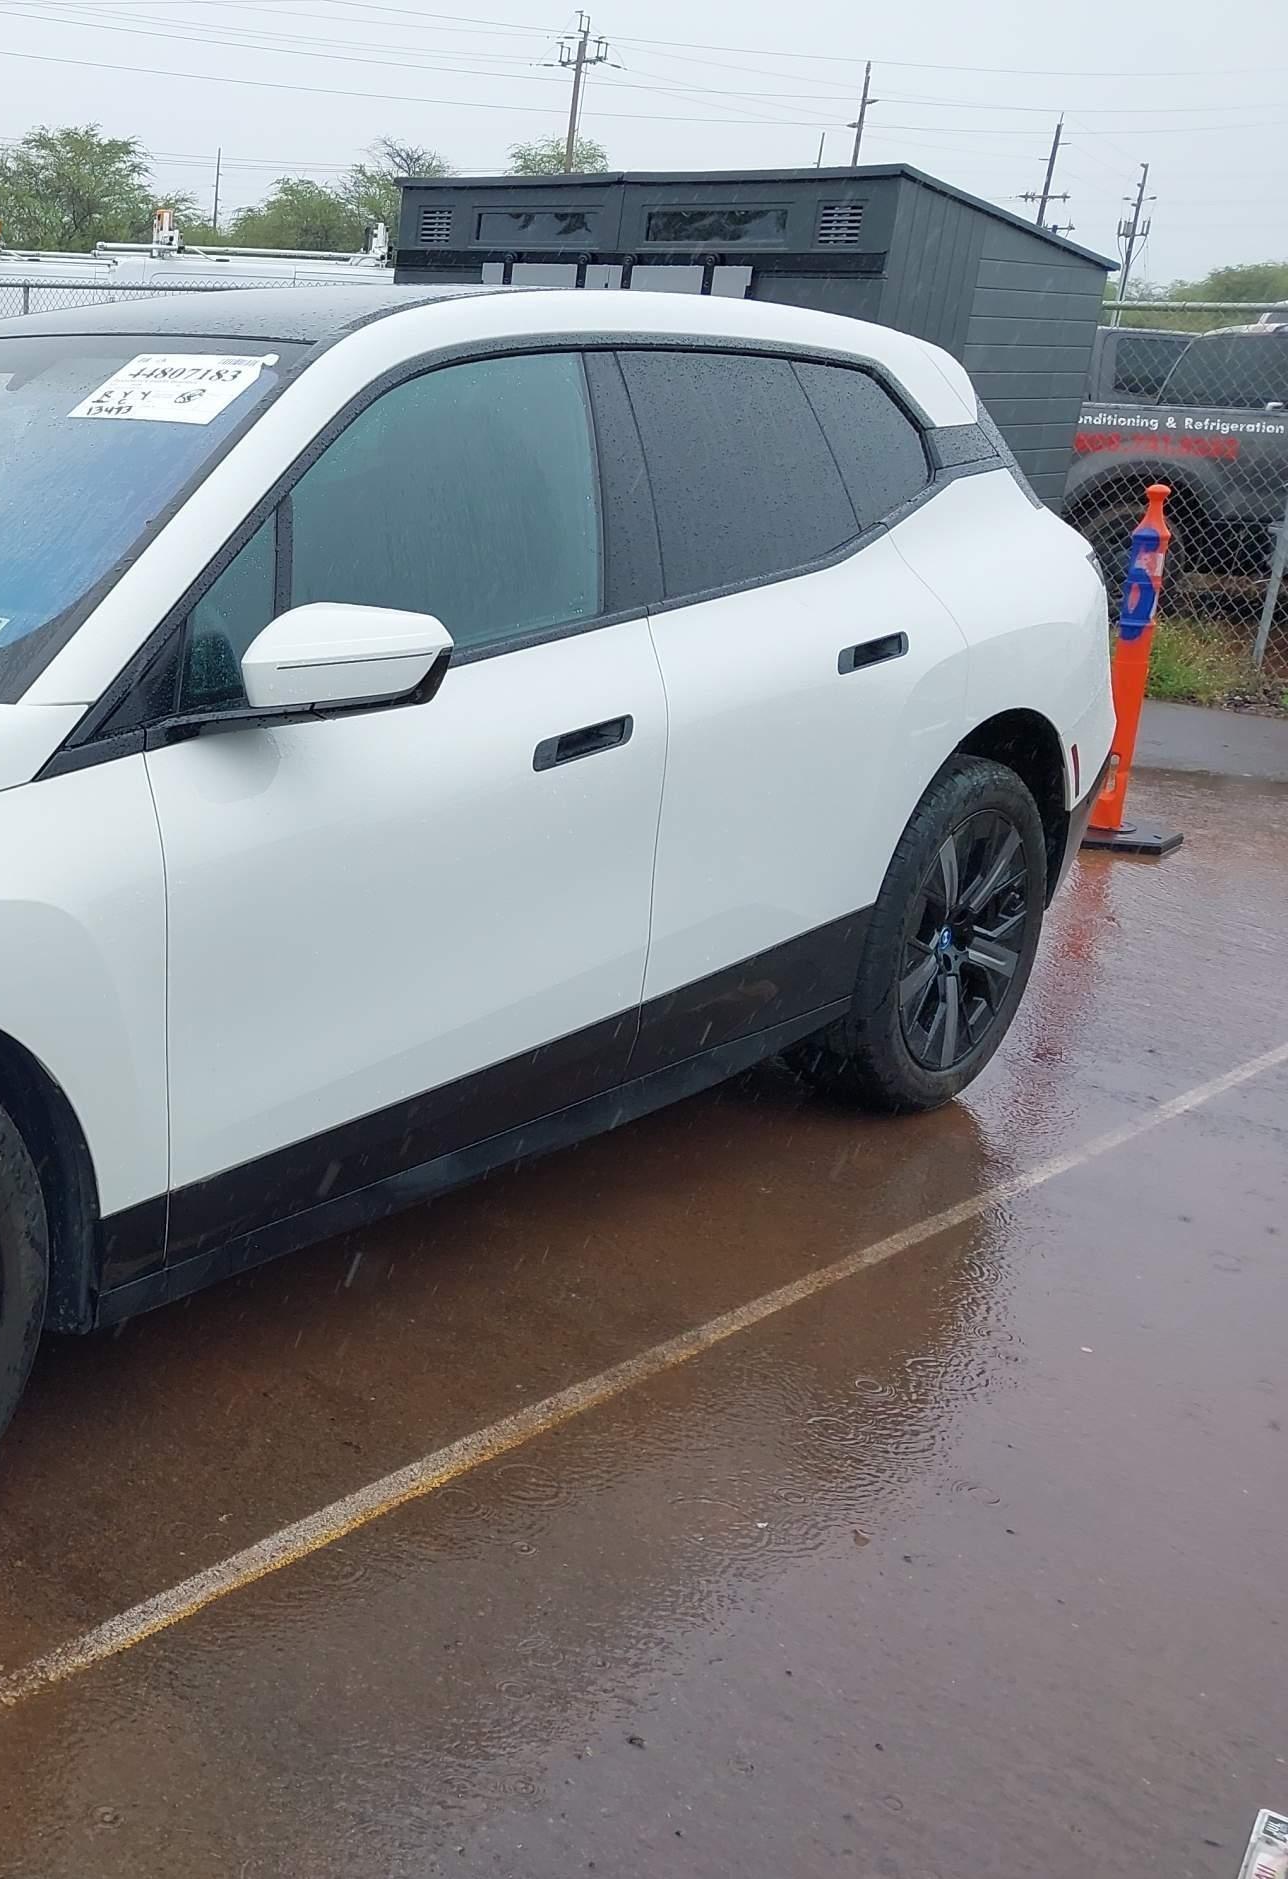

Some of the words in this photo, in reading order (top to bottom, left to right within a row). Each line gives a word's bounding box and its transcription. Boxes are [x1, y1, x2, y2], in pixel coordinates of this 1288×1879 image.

[128, 367, 242, 382] 44807183
[1165, 416, 1177, 430] &
[1184, 417, 1285, 434] Refrigeration
